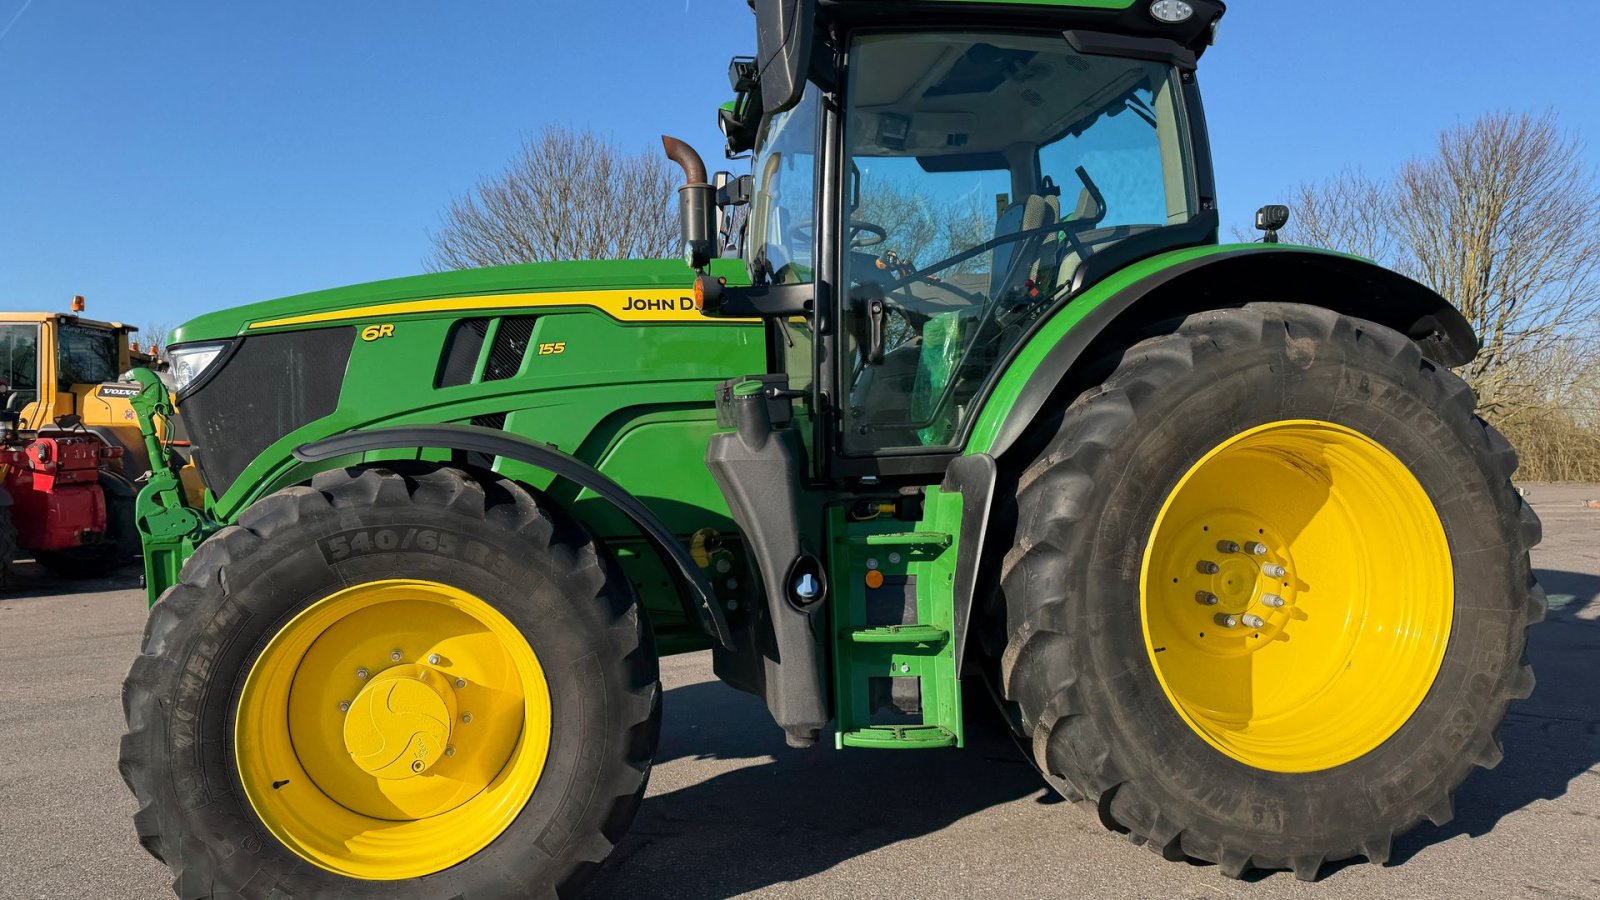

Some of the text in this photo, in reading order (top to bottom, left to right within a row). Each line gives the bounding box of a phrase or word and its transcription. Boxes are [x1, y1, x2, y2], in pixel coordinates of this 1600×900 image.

[622, 297, 675, 311] JOHN
[361, 324, 395, 341] 6R
[539, 342, 566, 355] 155
[328, 529, 457, 560] 540/65
